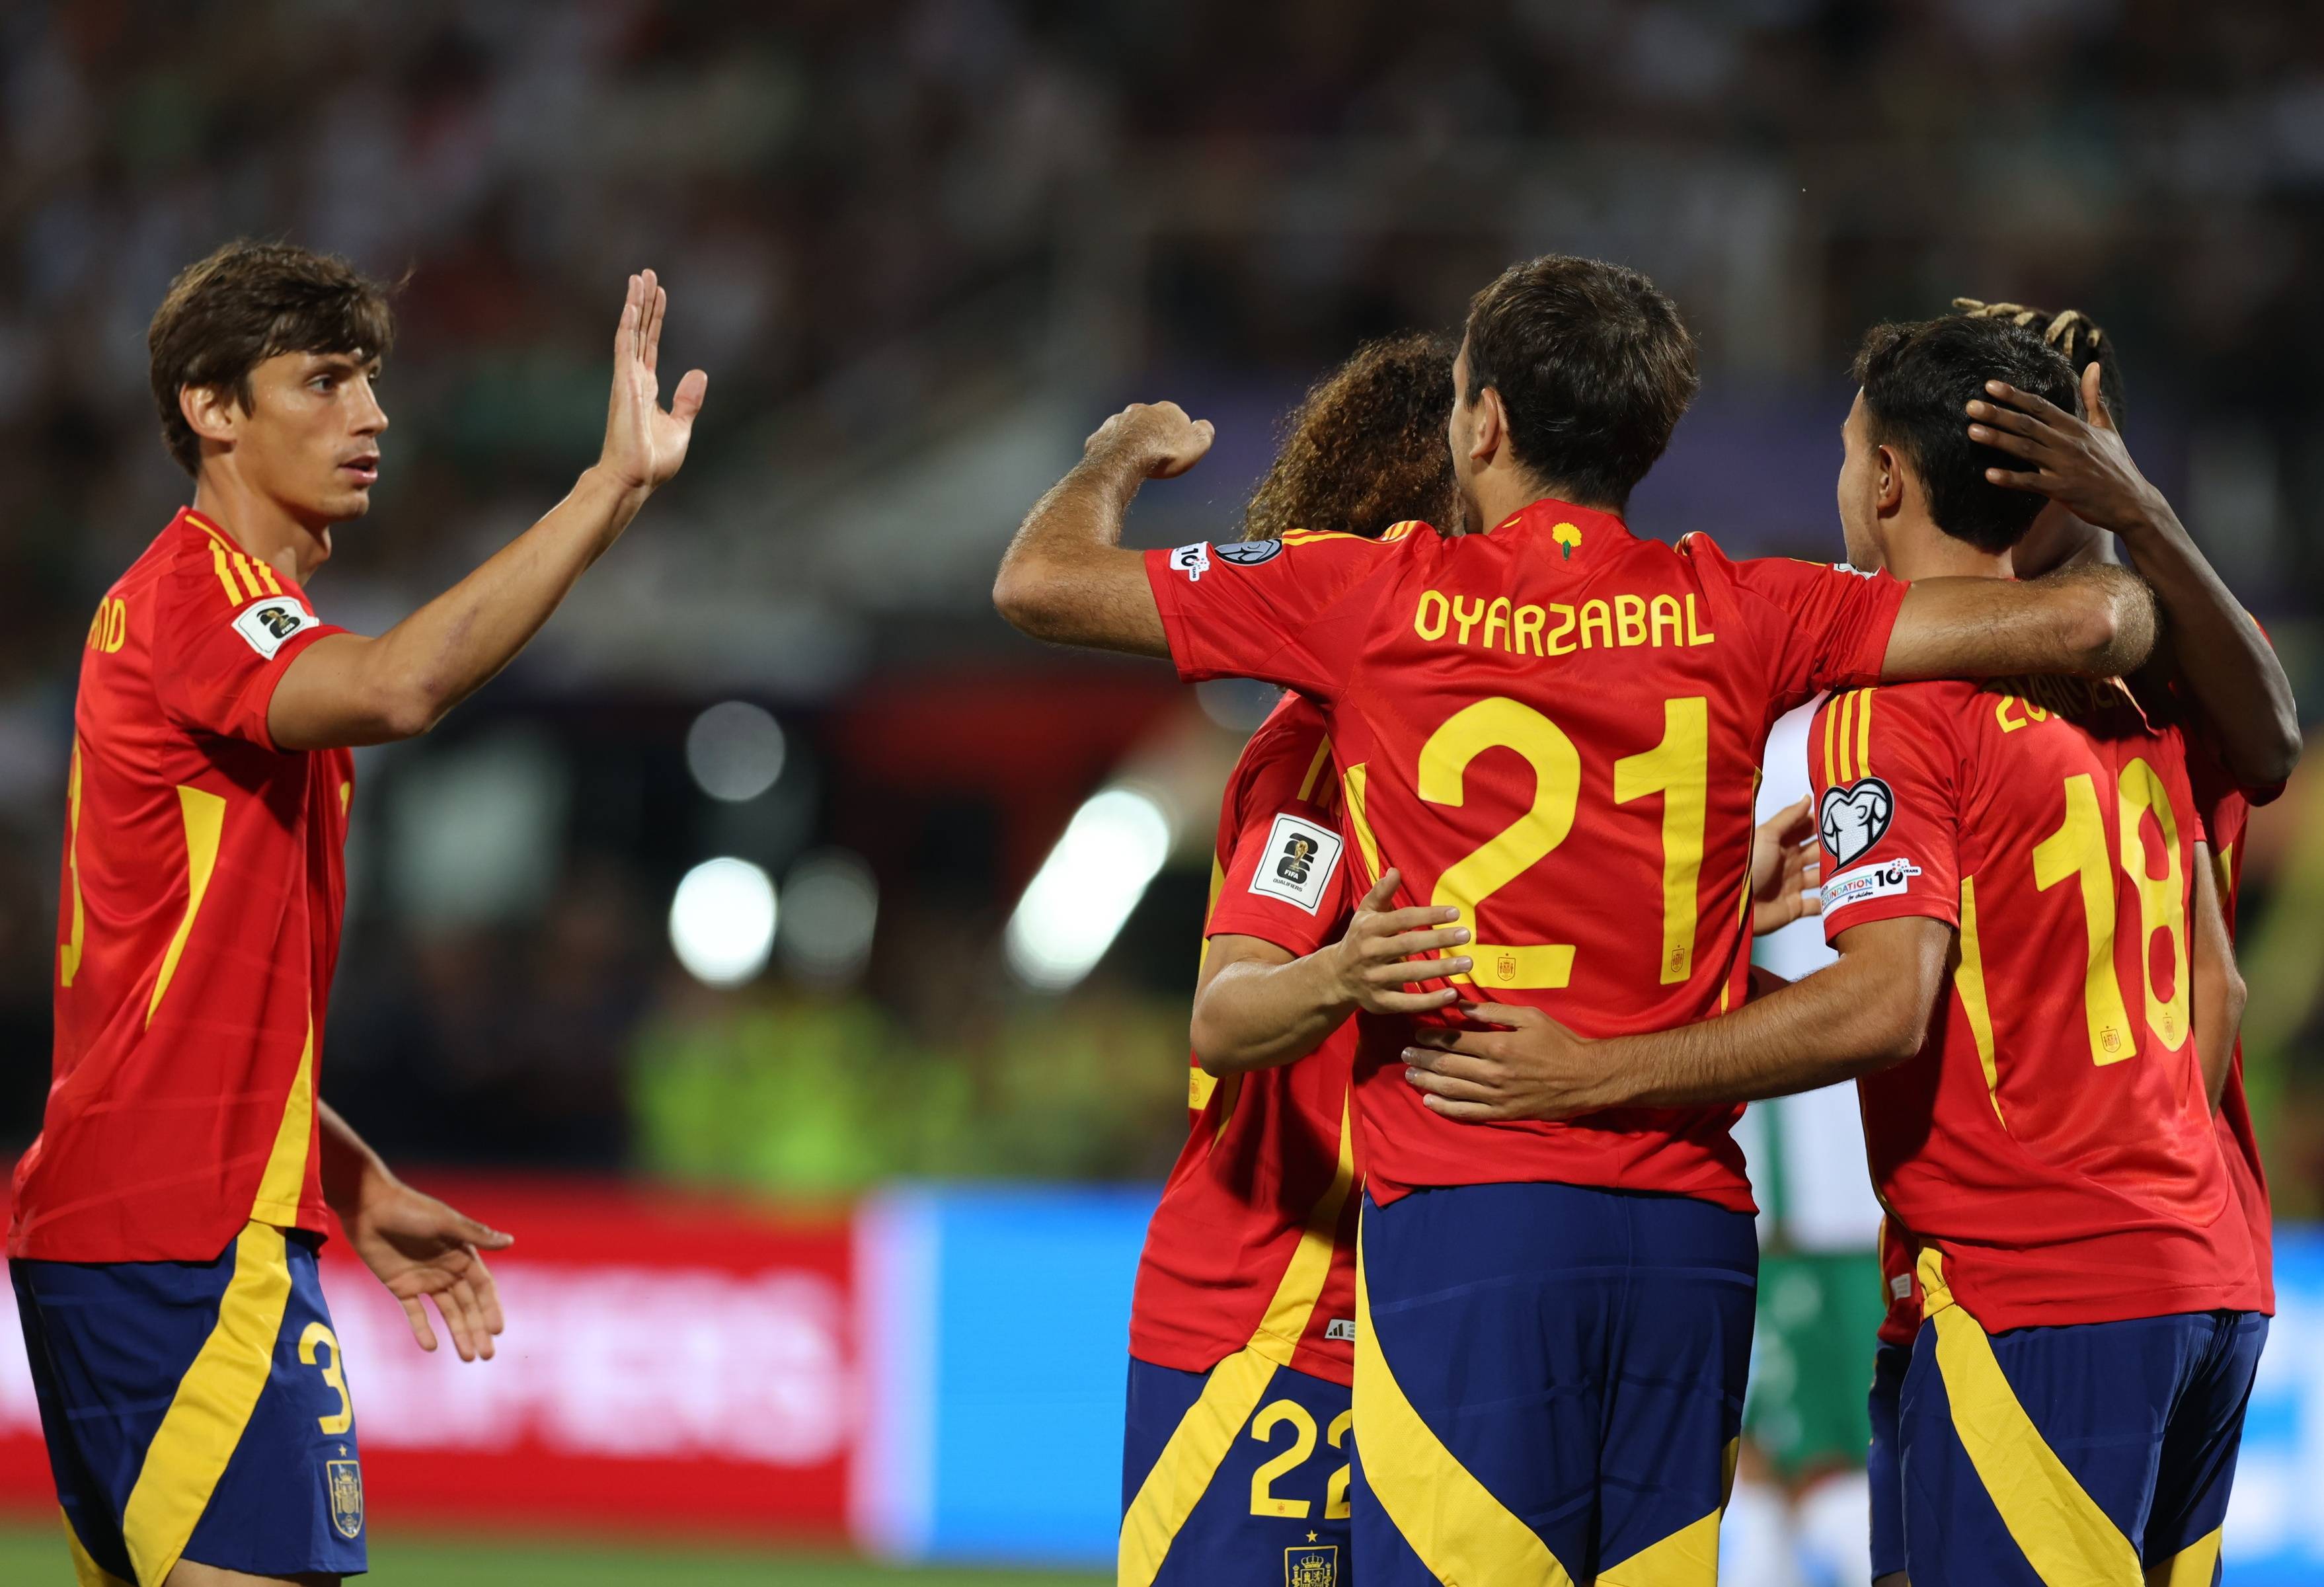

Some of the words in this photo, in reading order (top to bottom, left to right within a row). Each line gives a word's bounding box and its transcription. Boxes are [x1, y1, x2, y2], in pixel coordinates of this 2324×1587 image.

[1413, 590, 1715, 657] OYARZABAL
[1284, 869, 1299, 880] FIFA
[1418, 696, 1708, 989] 21
[1272, 878, 1303, 892] QUALIFIERS
[1874, 869, 1904, 887] 10
[2032, 756, 2190, 1067] 18
[298, 1321, 352, 1435] 3
